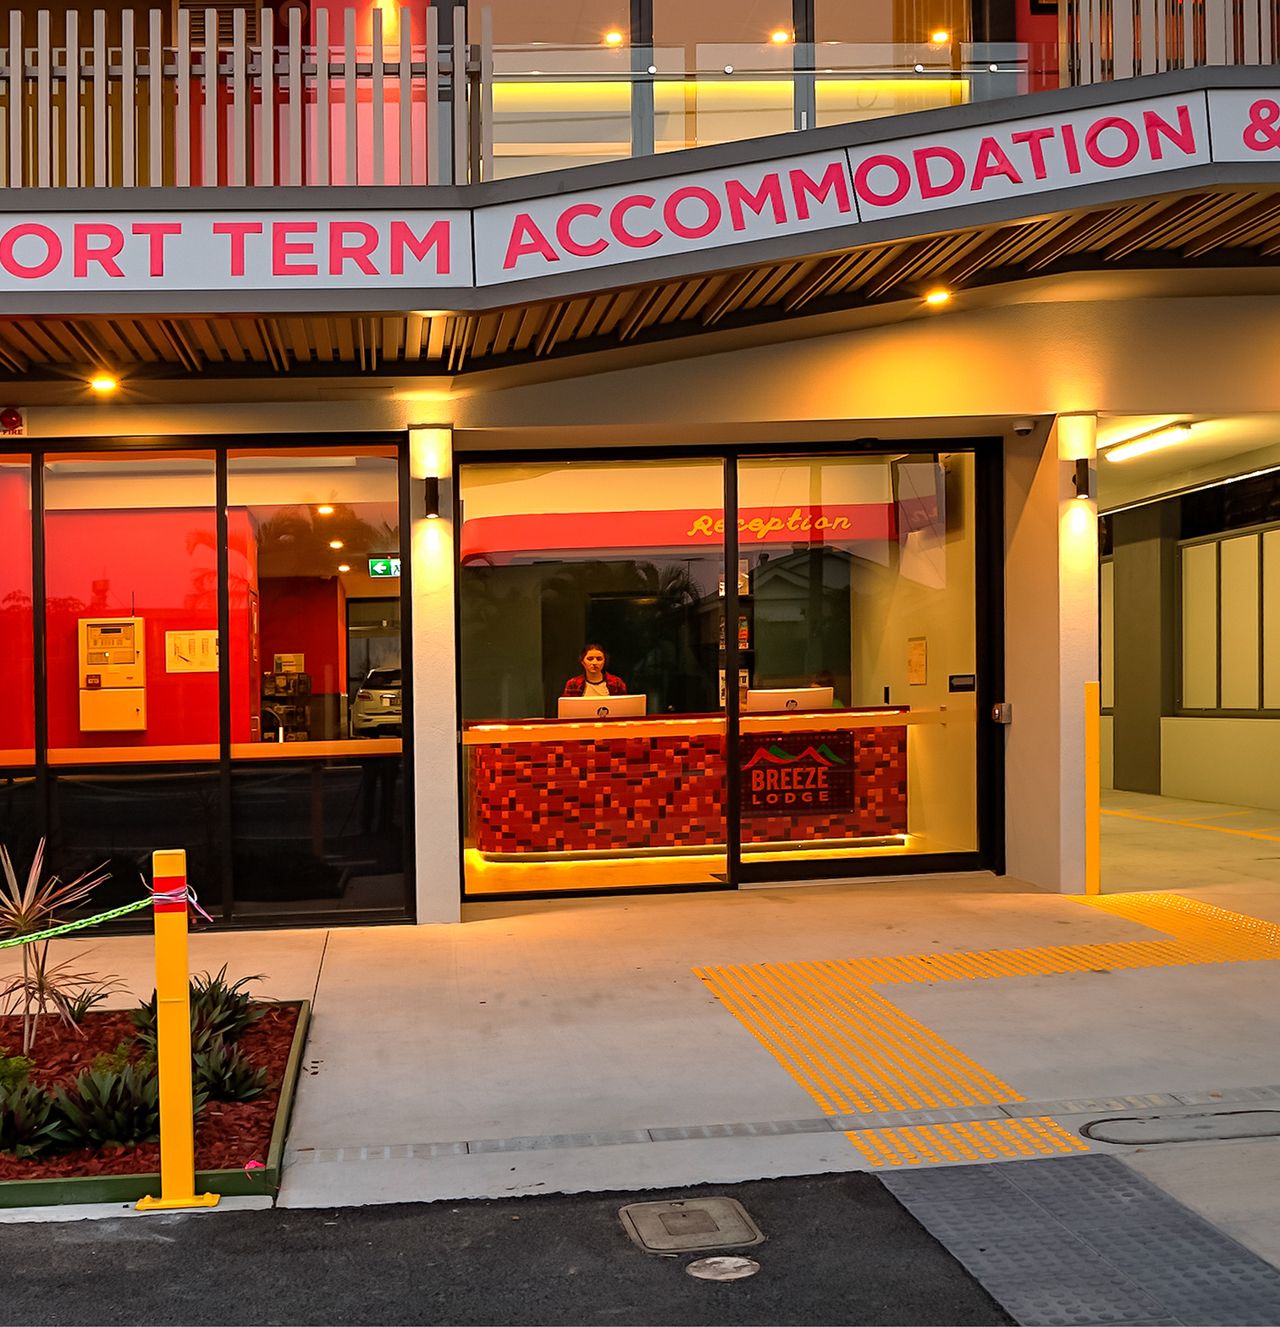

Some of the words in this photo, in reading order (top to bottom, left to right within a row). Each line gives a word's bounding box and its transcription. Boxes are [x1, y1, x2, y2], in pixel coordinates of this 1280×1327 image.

[212, 219, 452, 278] TERM
[503, 104, 1198, 271] ACCOMMODATION
[687, 508, 852, 539] Reception
[751, 766, 829, 792] BREEZE
[752, 791, 829, 805] LODGE
